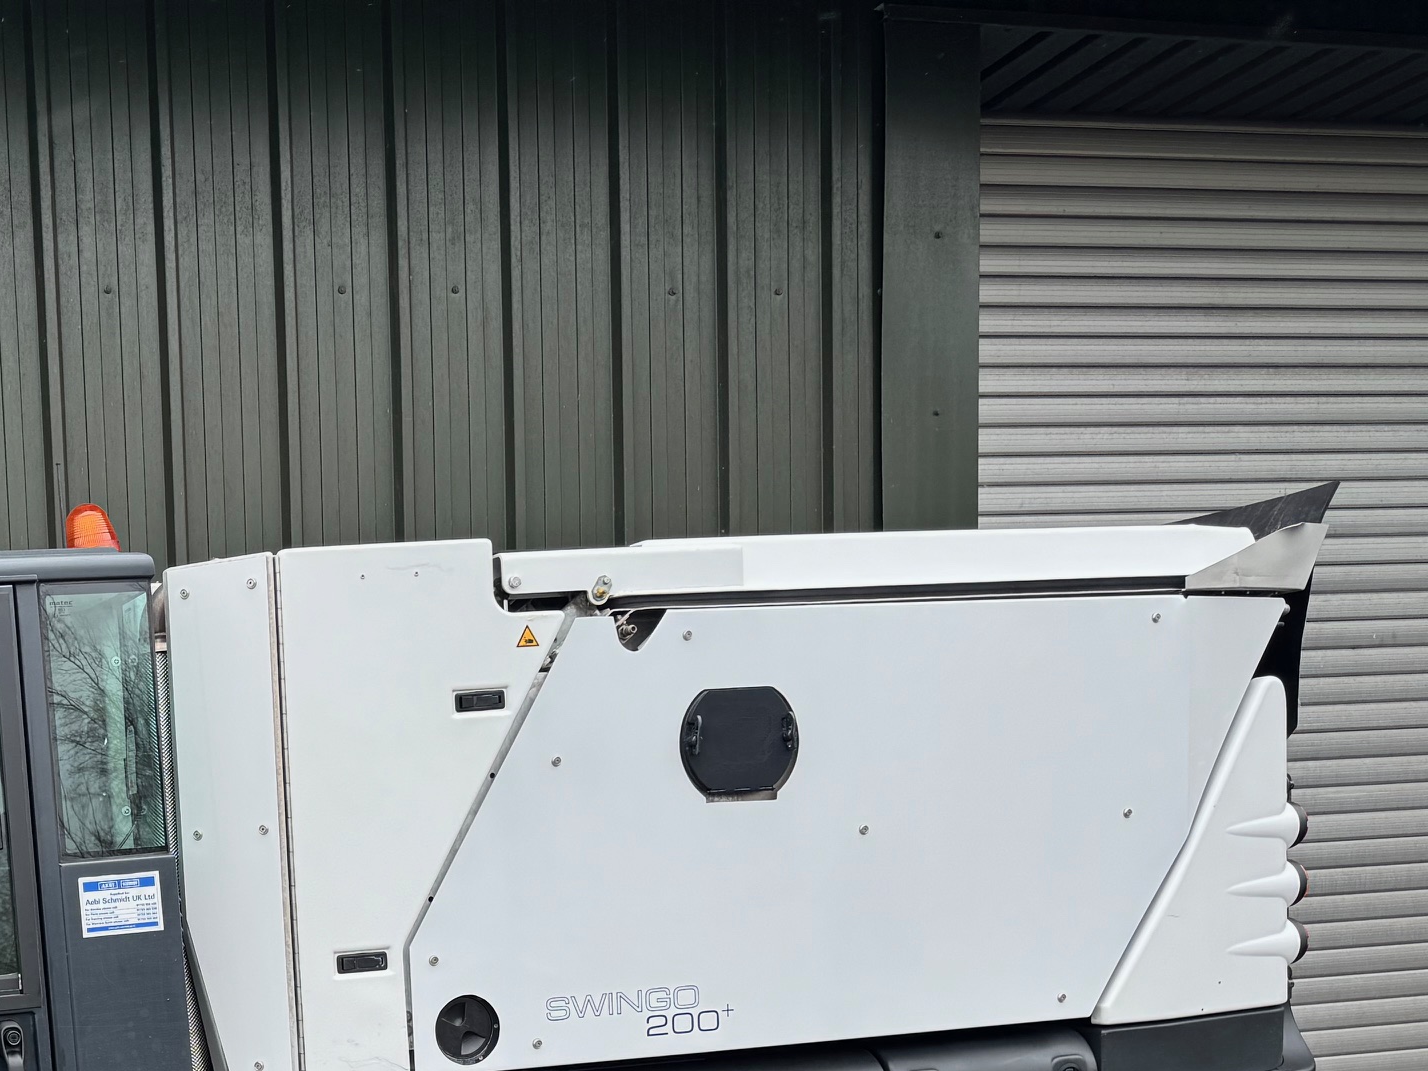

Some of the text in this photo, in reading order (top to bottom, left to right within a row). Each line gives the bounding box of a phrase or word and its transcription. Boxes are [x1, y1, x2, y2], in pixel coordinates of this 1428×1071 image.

[85, 898, 101, 906] Aebi
[102, 895, 130, 905] Schmidt
[545, 984, 700, 1021] SWINGO
